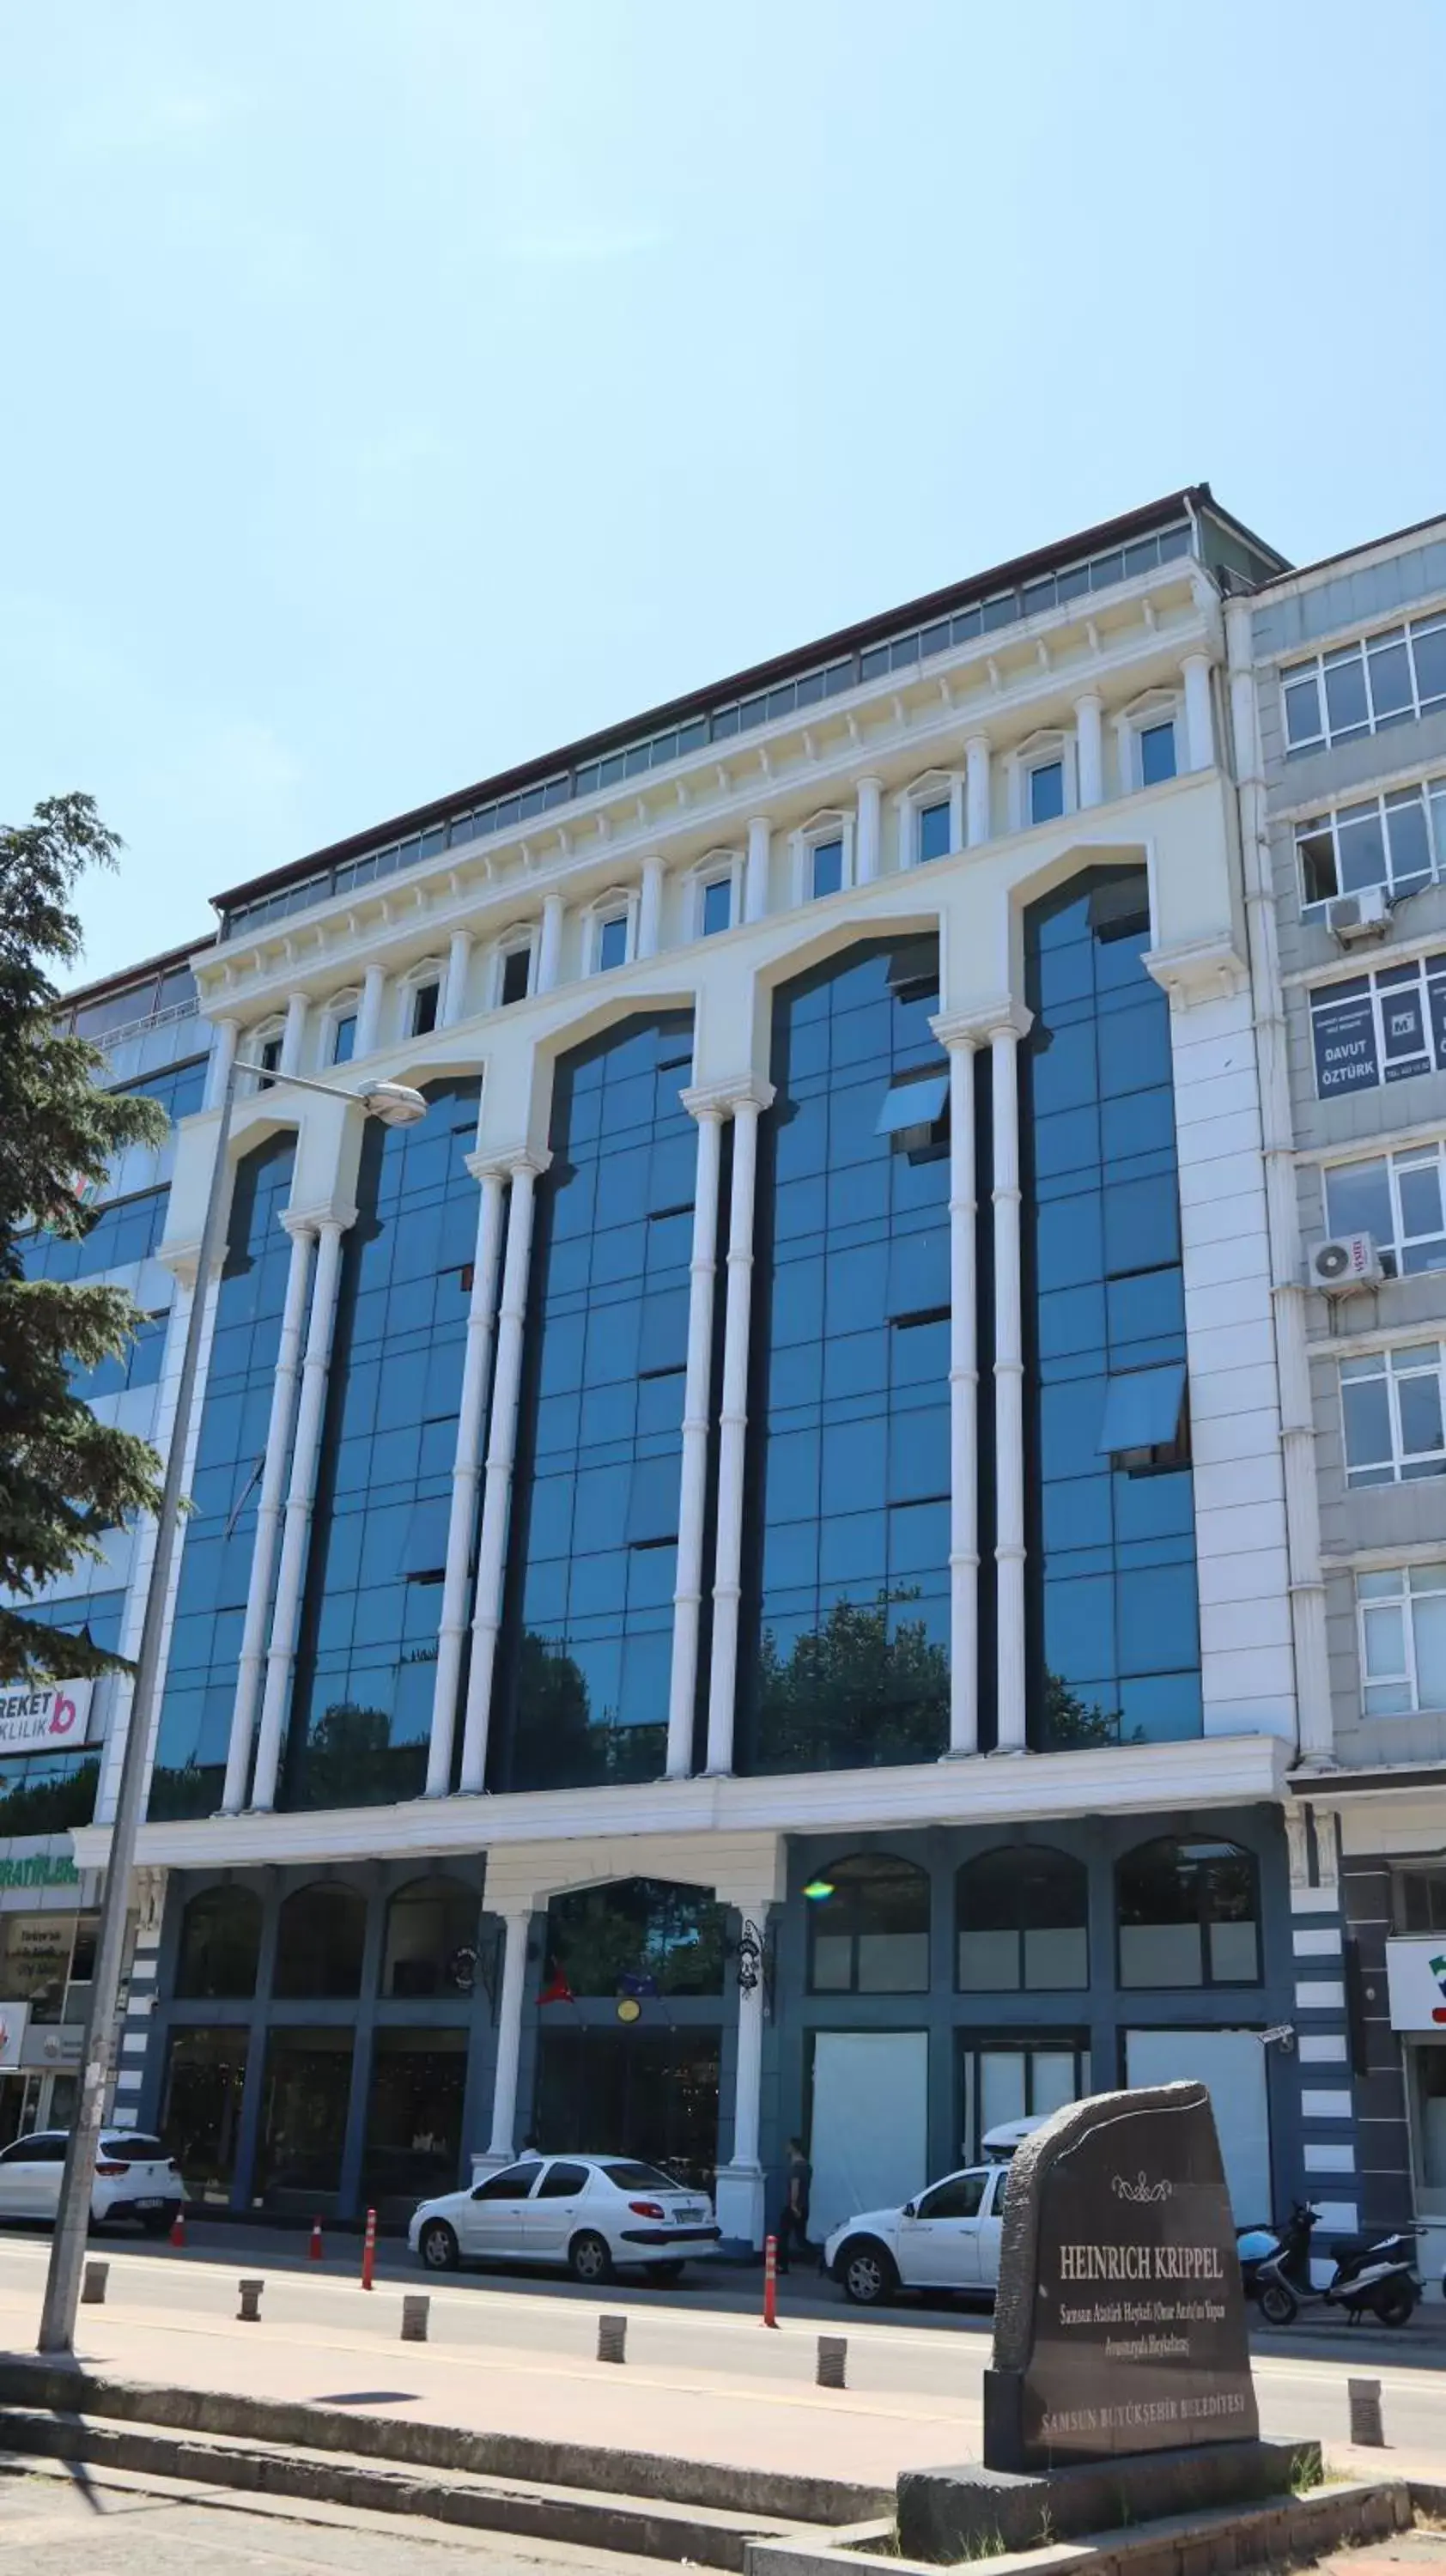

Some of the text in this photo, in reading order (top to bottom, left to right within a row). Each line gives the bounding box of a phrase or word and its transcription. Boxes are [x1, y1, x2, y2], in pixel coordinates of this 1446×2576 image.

[1325, 1039, 1367, 1062] DAVUT
[1322, 1060, 1375, 1084] ÖZTÜRK
[0, 1692, 52, 1718] REKET
[1060, 2245, 1224, 2280] HEINRICH KRIPPEL
[1041, 2408, 1097, 2434] SAMSUN
